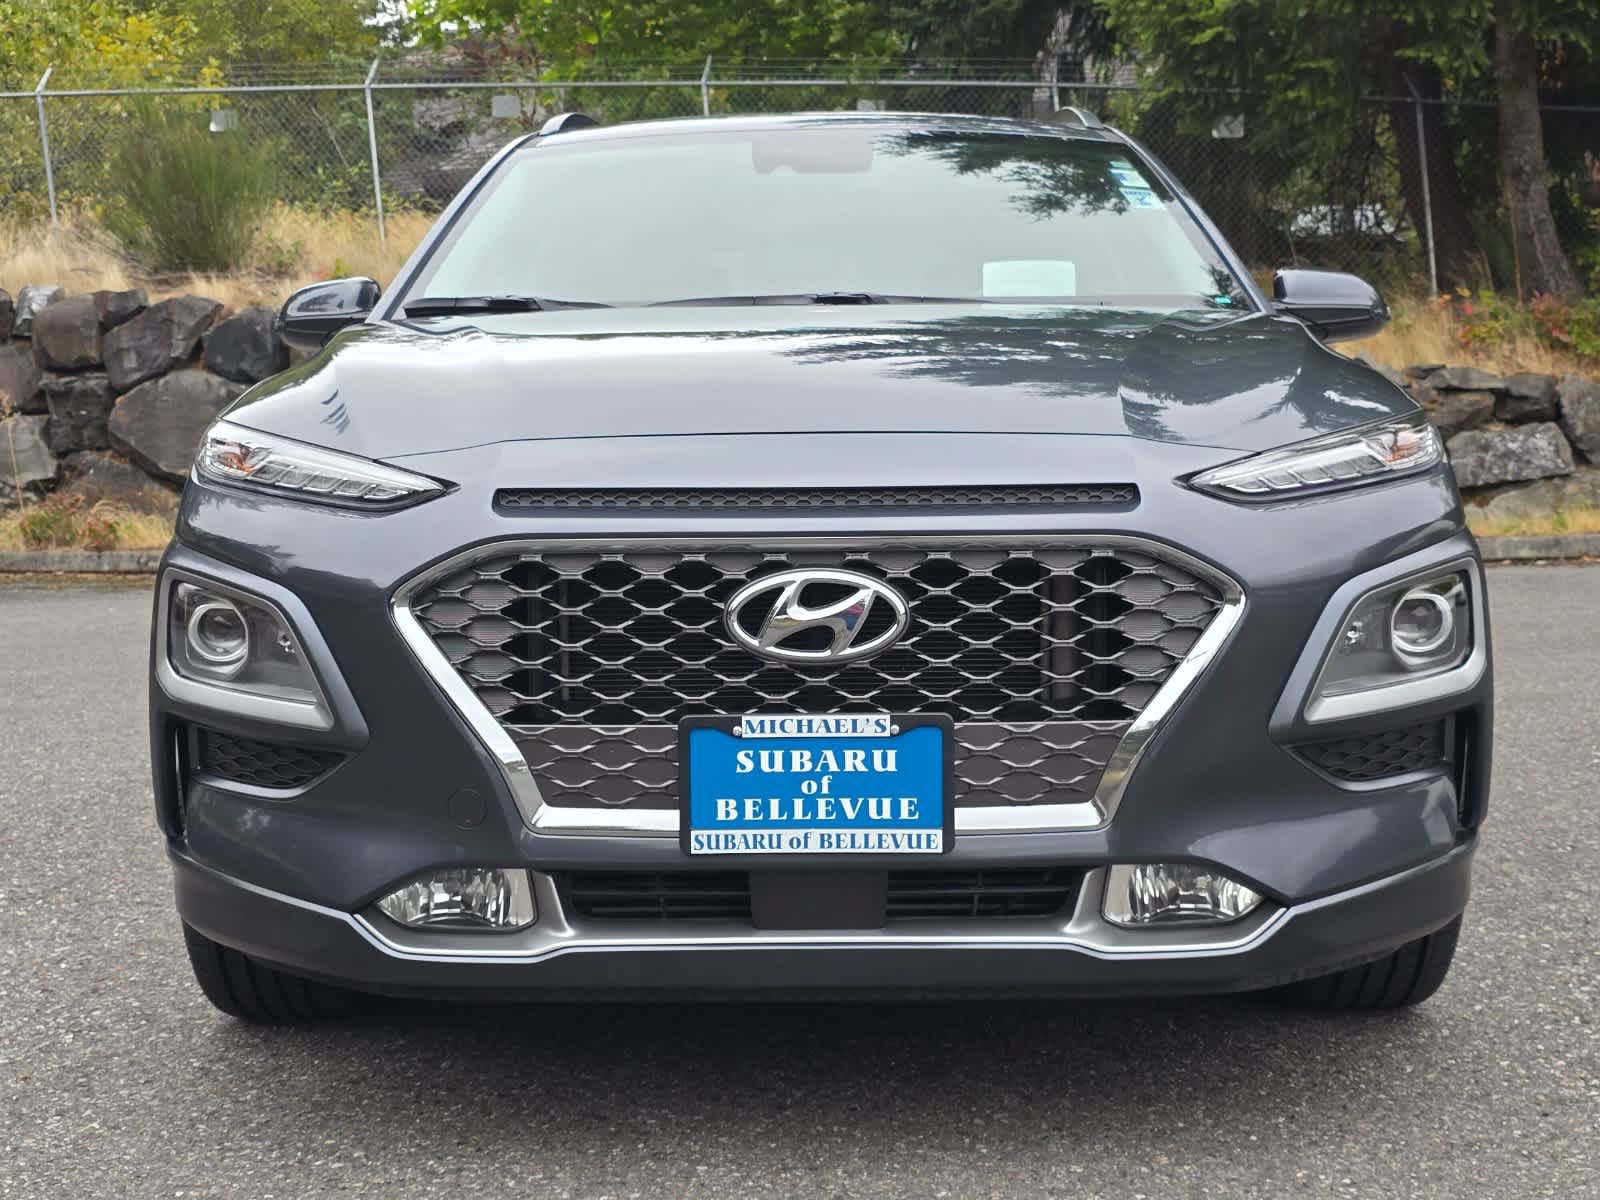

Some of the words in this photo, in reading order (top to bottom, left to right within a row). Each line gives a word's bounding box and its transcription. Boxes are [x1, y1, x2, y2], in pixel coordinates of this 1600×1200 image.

[744, 718, 887, 735] MICHAEL'S
[736, 749, 898, 773] SUBARU
[800, 775, 833, 795] of
[715, 797, 920, 821] BELLEVUE
[693, 833, 783, 851] SUBARU
[788, 831, 812, 849] of
[818, 832, 938, 850] BELLEVUE
